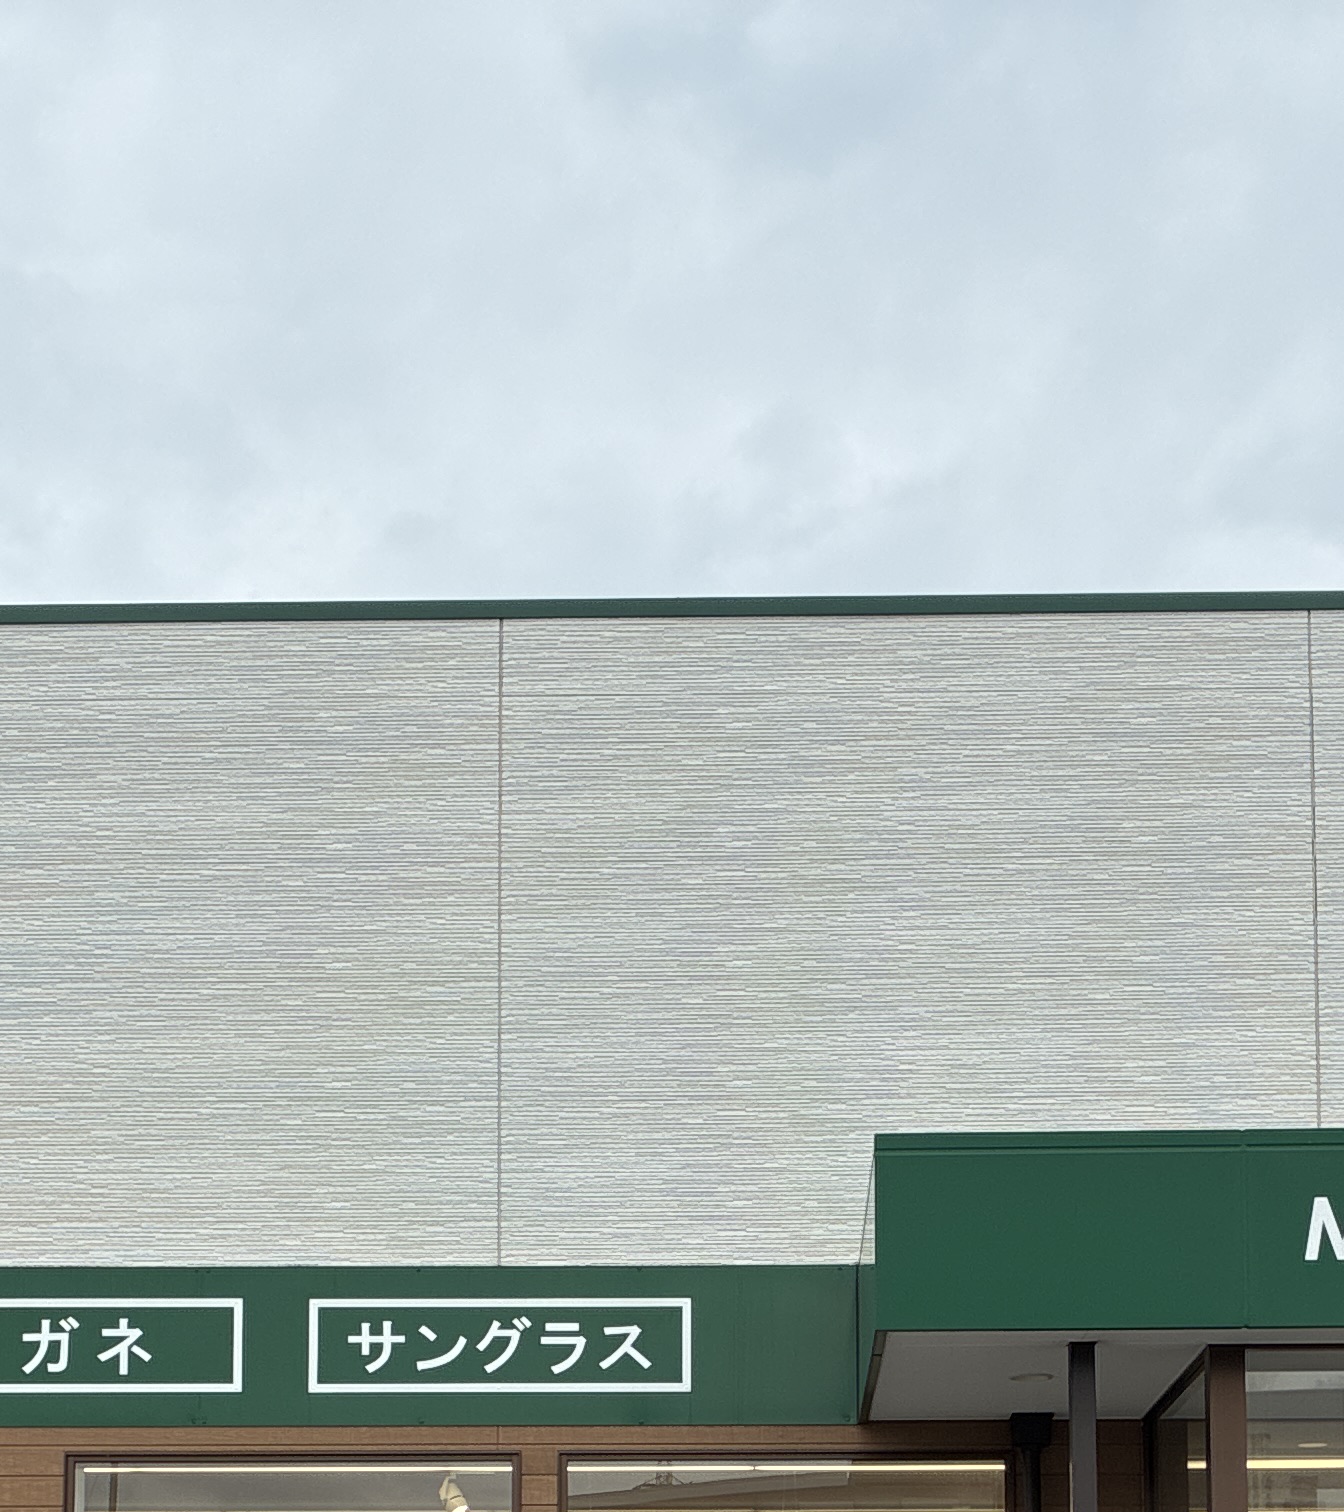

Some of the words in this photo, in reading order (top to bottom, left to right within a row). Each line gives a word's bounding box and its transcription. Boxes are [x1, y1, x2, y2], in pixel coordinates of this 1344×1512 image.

[346, 1314, 655, 1376] サングラス
